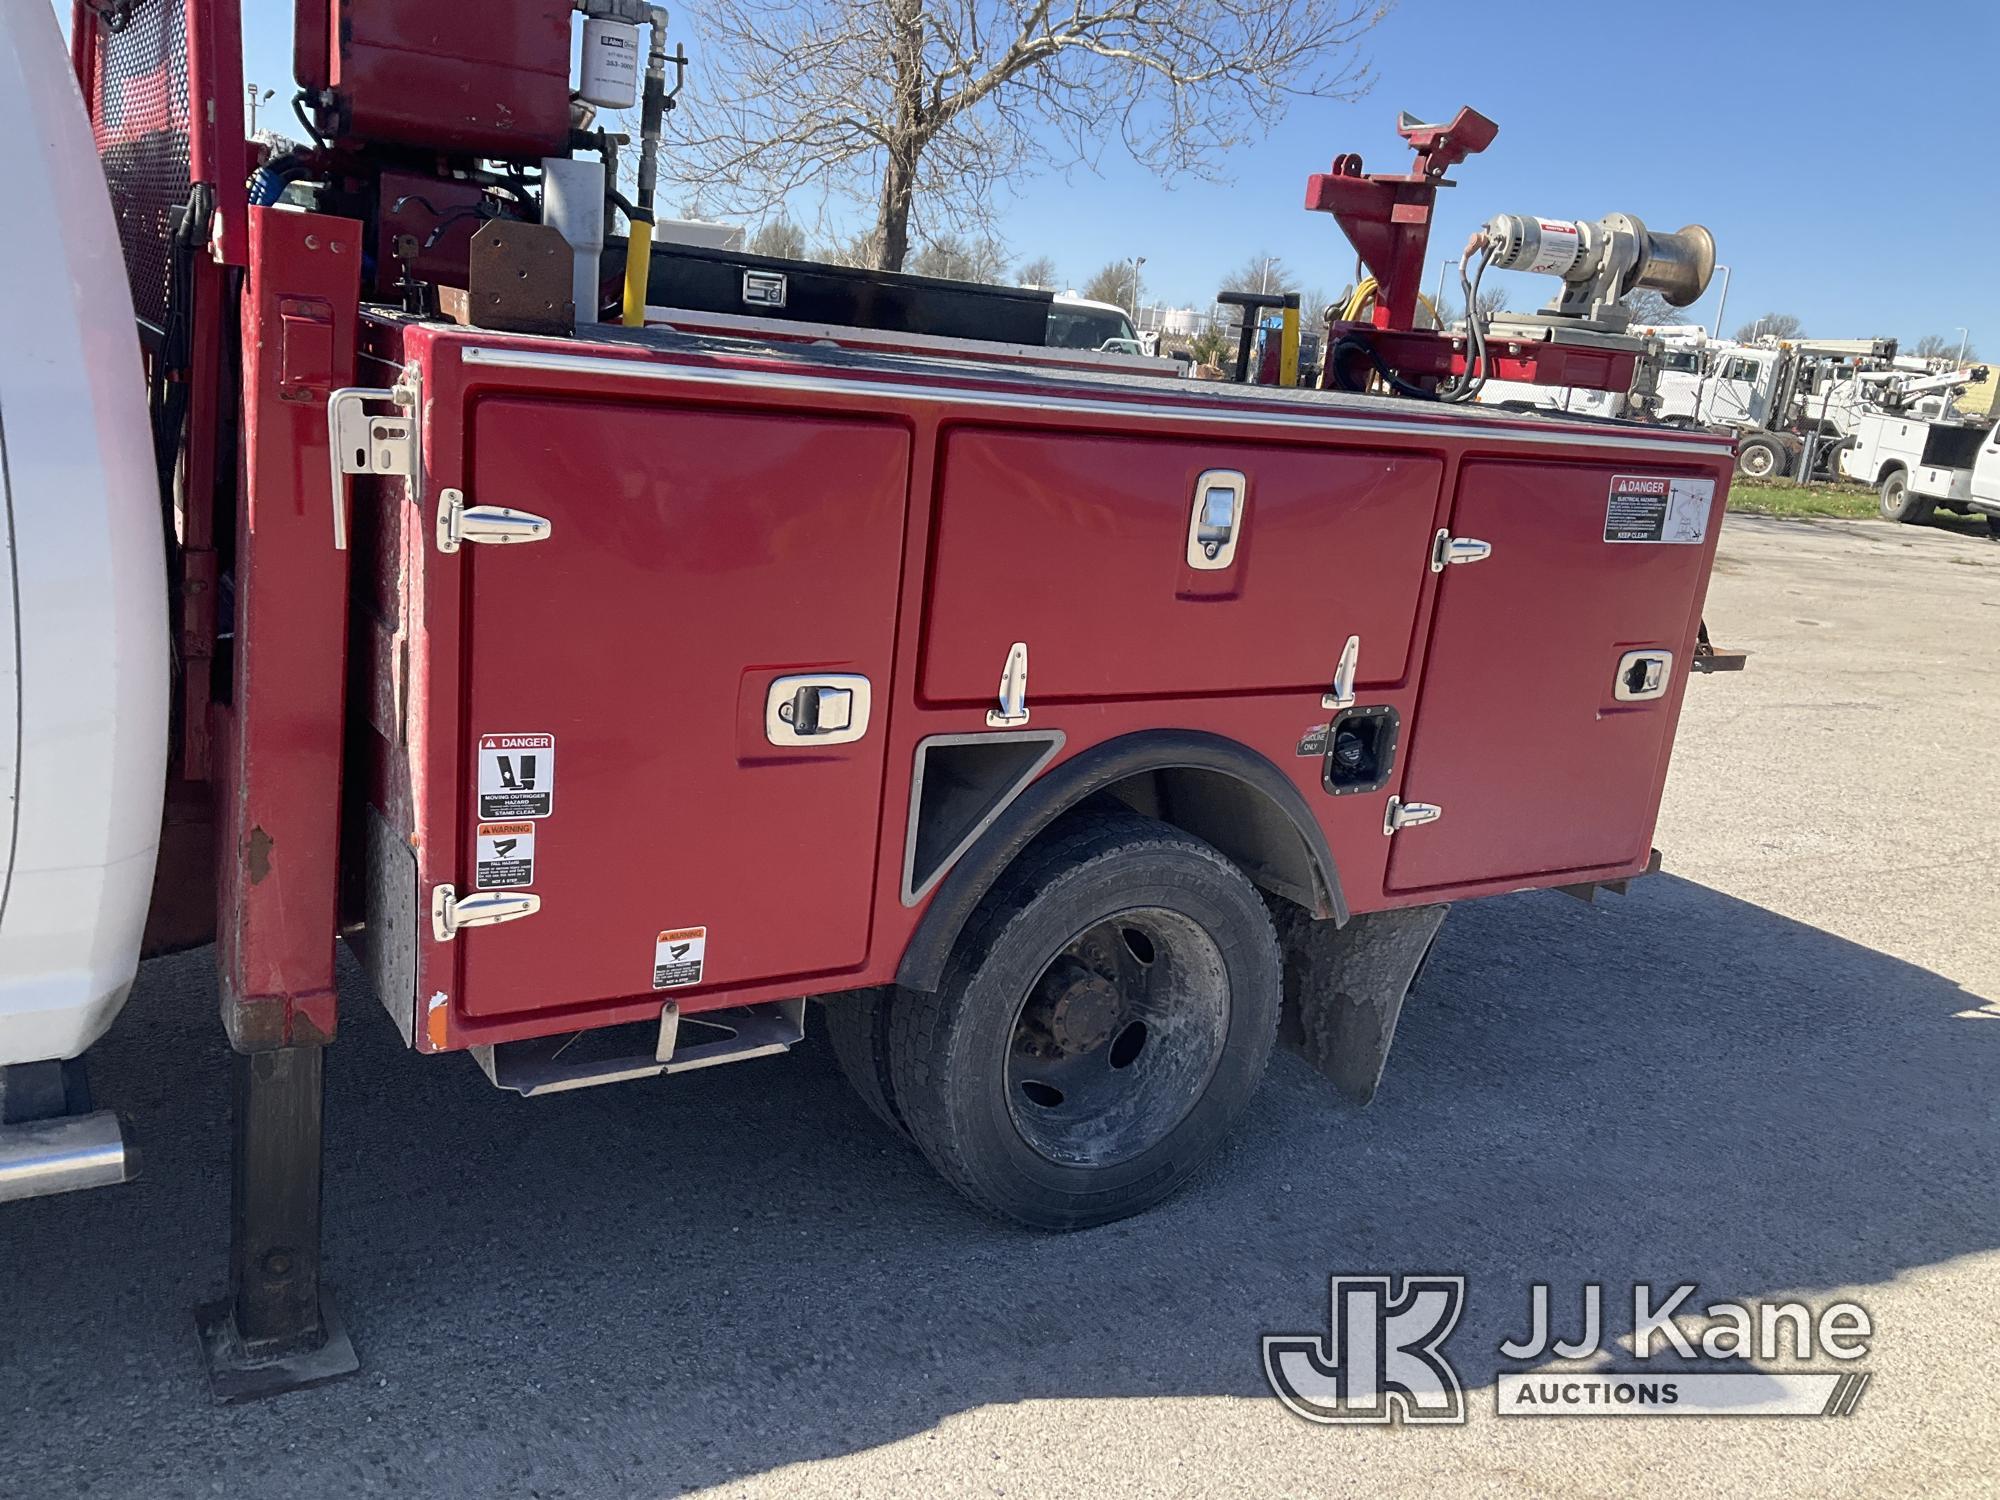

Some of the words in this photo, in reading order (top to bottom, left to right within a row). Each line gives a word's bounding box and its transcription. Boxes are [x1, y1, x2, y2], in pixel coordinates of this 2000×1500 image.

[1628, 481, 1664, 493] DANGER
[502, 738, 549, 748] DANGER
[1303, 743, 1317, 751] ONLY
[491, 825, 530, 834] WARNING
[670, 929, 702, 940] WARNING
